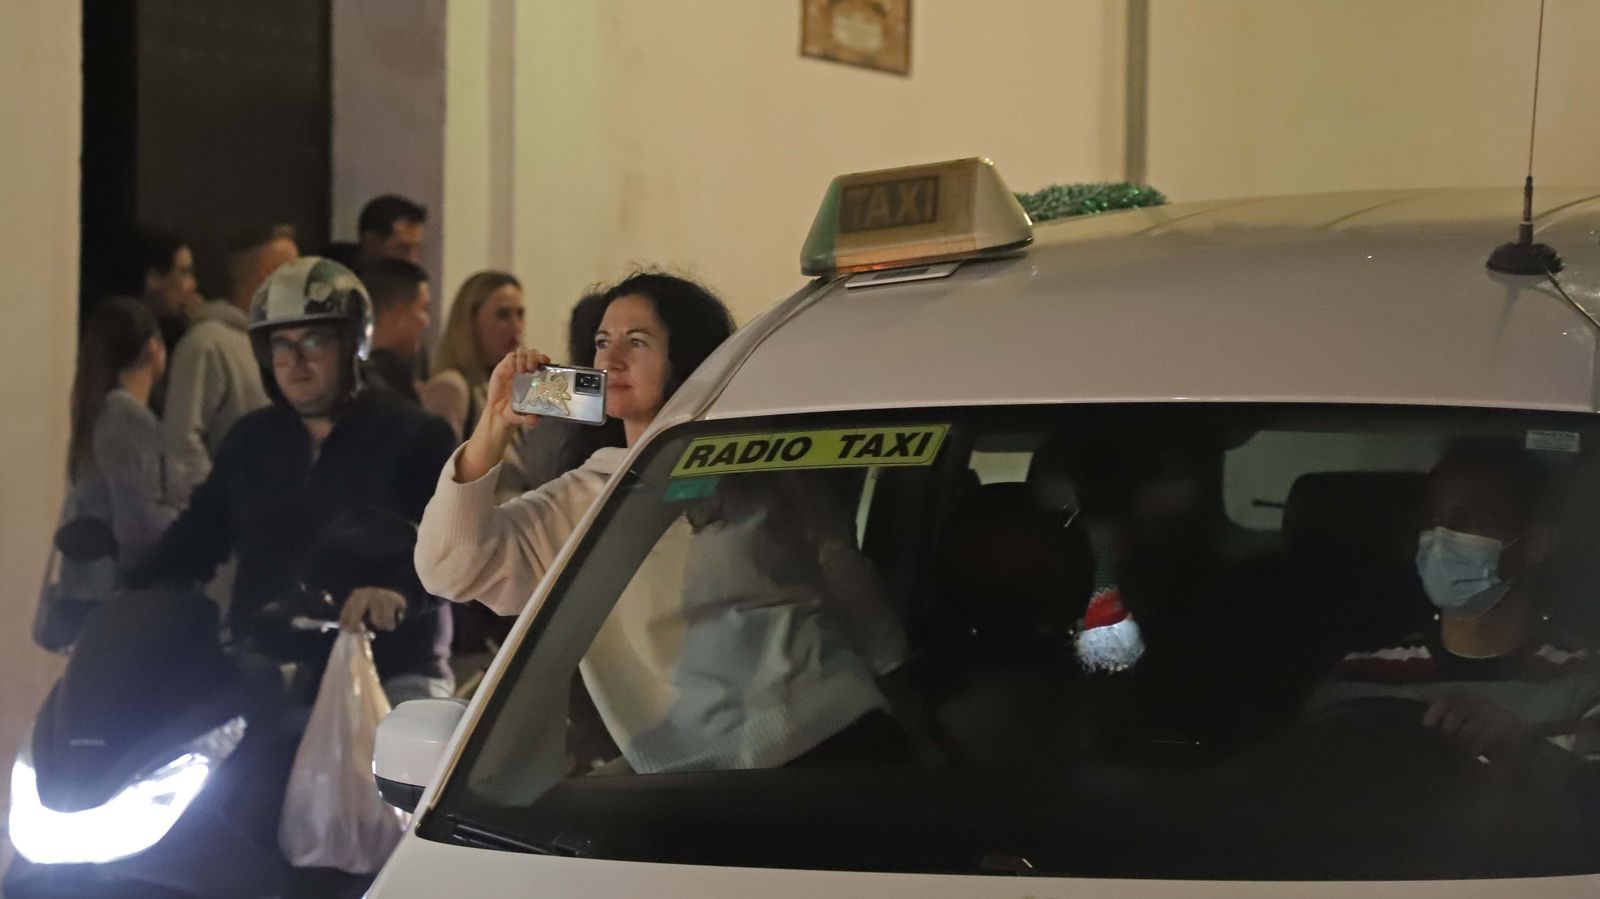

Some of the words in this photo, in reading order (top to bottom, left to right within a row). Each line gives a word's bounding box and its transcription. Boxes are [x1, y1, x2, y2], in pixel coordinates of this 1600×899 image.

[846, 179, 934, 229] TAXI
[682, 436, 813, 470] RADIO
[837, 432, 934, 459] TAXI
